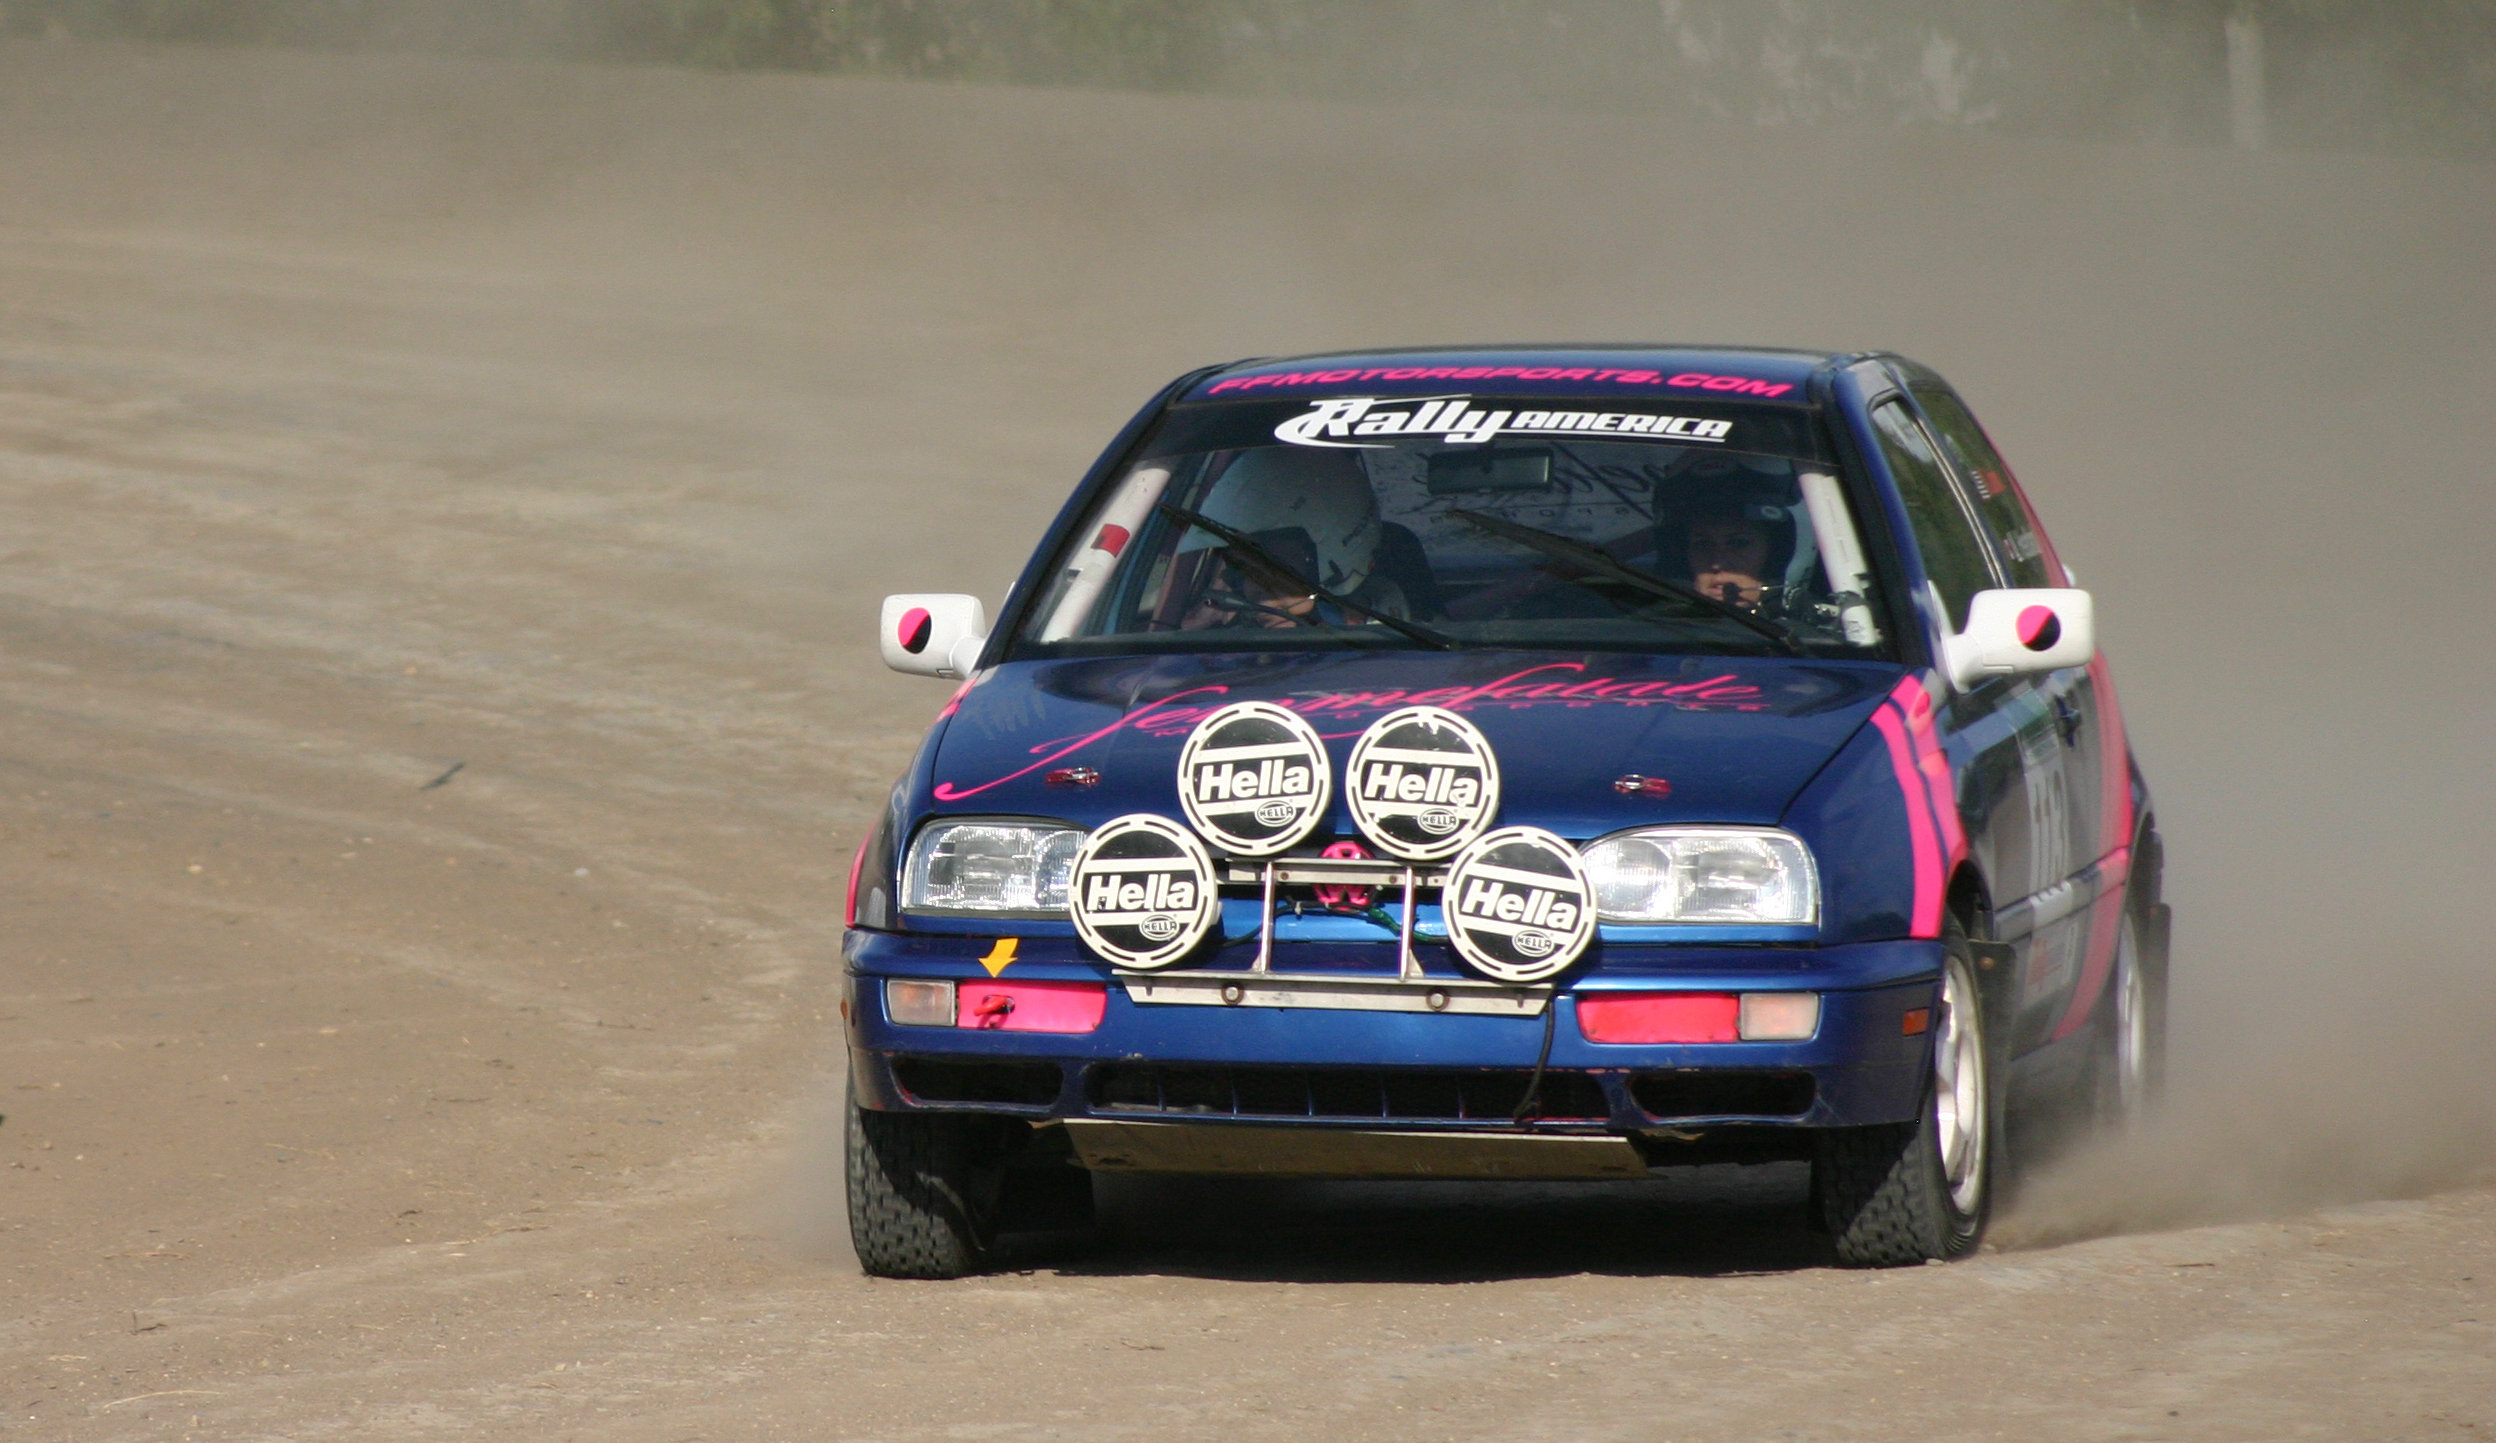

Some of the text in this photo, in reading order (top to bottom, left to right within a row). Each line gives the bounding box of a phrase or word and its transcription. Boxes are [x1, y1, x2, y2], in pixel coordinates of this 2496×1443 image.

[1208, 366, 1794, 398] FFMOTORSPORTS.COM
[1274, 397, 1733, 447] Rally AMERICA
[1199, 759, 1310, 801] Hella
[1364, 763, 1478, 806] Hella
[1258, 806, 1294, 817] HELLA
[1421, 815, 1457, 827] HELLA
[1086, 874, 1195, 911] Hella
[1461, 879, 1577, 931] Hella
[1143, 921, 1178, 931] HELLA
[1517, 936, 1552, 949] HELLA
